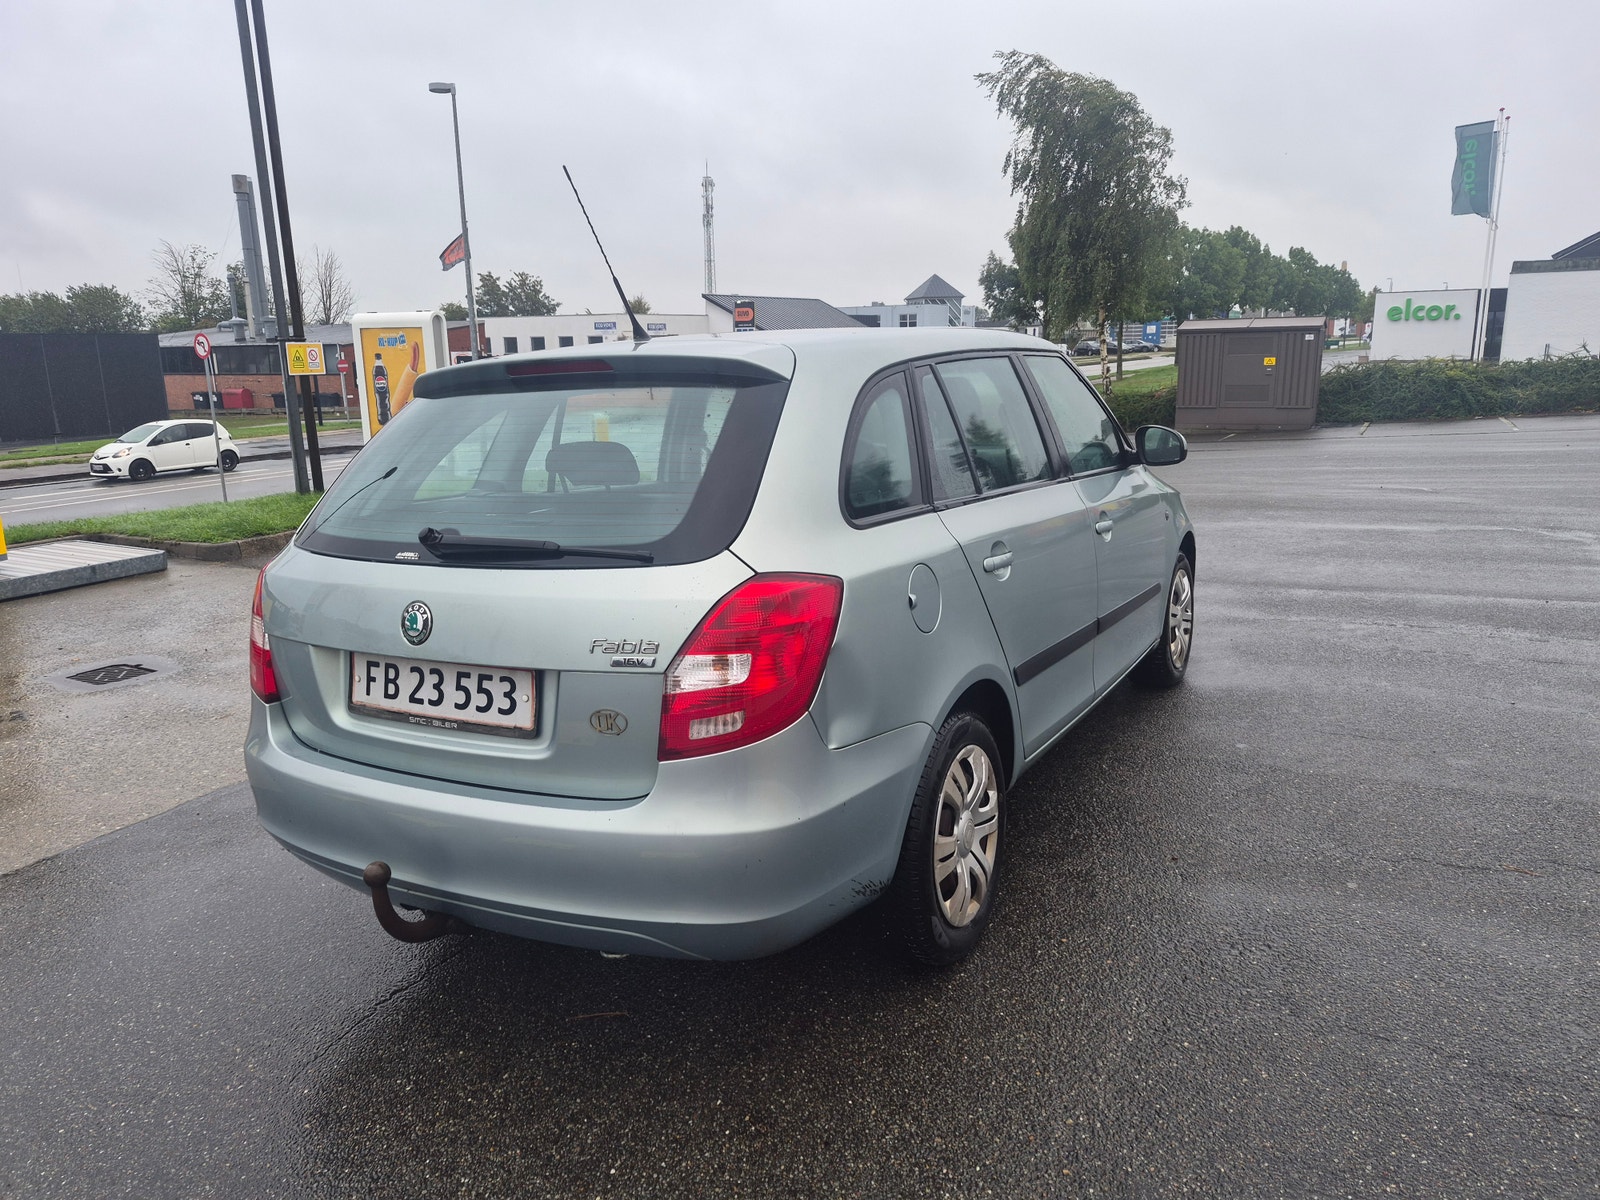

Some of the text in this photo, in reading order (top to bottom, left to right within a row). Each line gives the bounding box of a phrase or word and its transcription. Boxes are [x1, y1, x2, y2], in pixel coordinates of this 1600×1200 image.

[1387, 298, 1461, 321] elcor.
[589, 637, 660, 655] Fabia
[623, 657, 644, 666] 16V
[365, 660, 518, 716] FB 23 553
